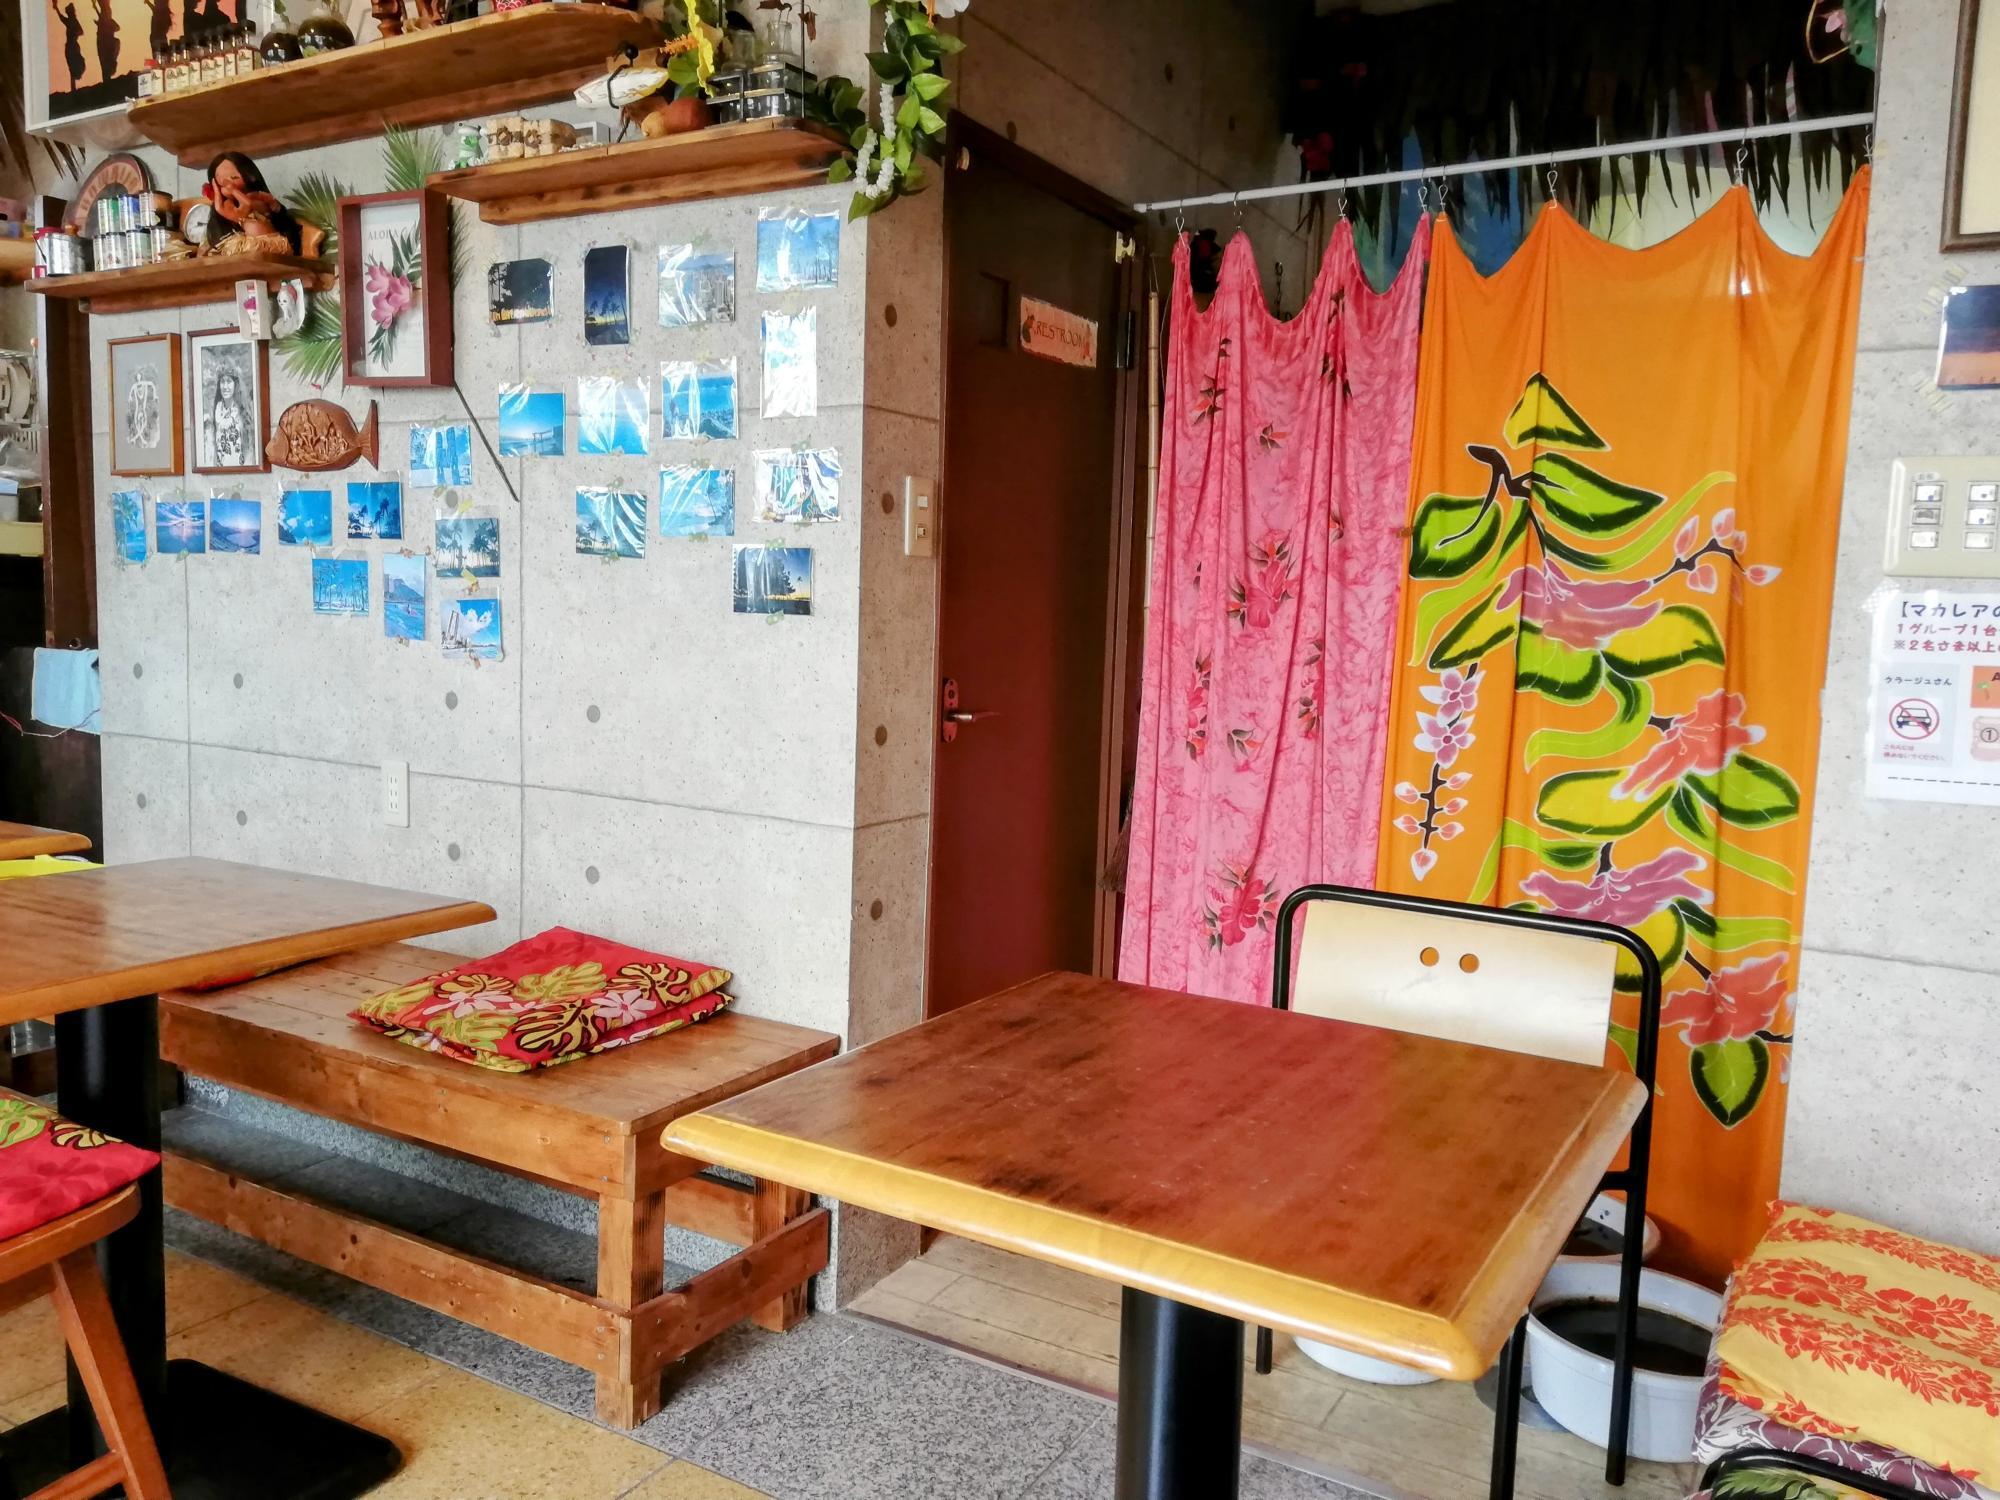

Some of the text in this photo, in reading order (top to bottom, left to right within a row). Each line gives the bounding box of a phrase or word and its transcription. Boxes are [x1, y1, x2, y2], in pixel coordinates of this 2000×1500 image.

[1036, 320, 1085, 349] RESTROOM
[1897, 623, 2000, 637] 1グループ1台
[1894, 639, 2000, 654] ※2名さま以上
